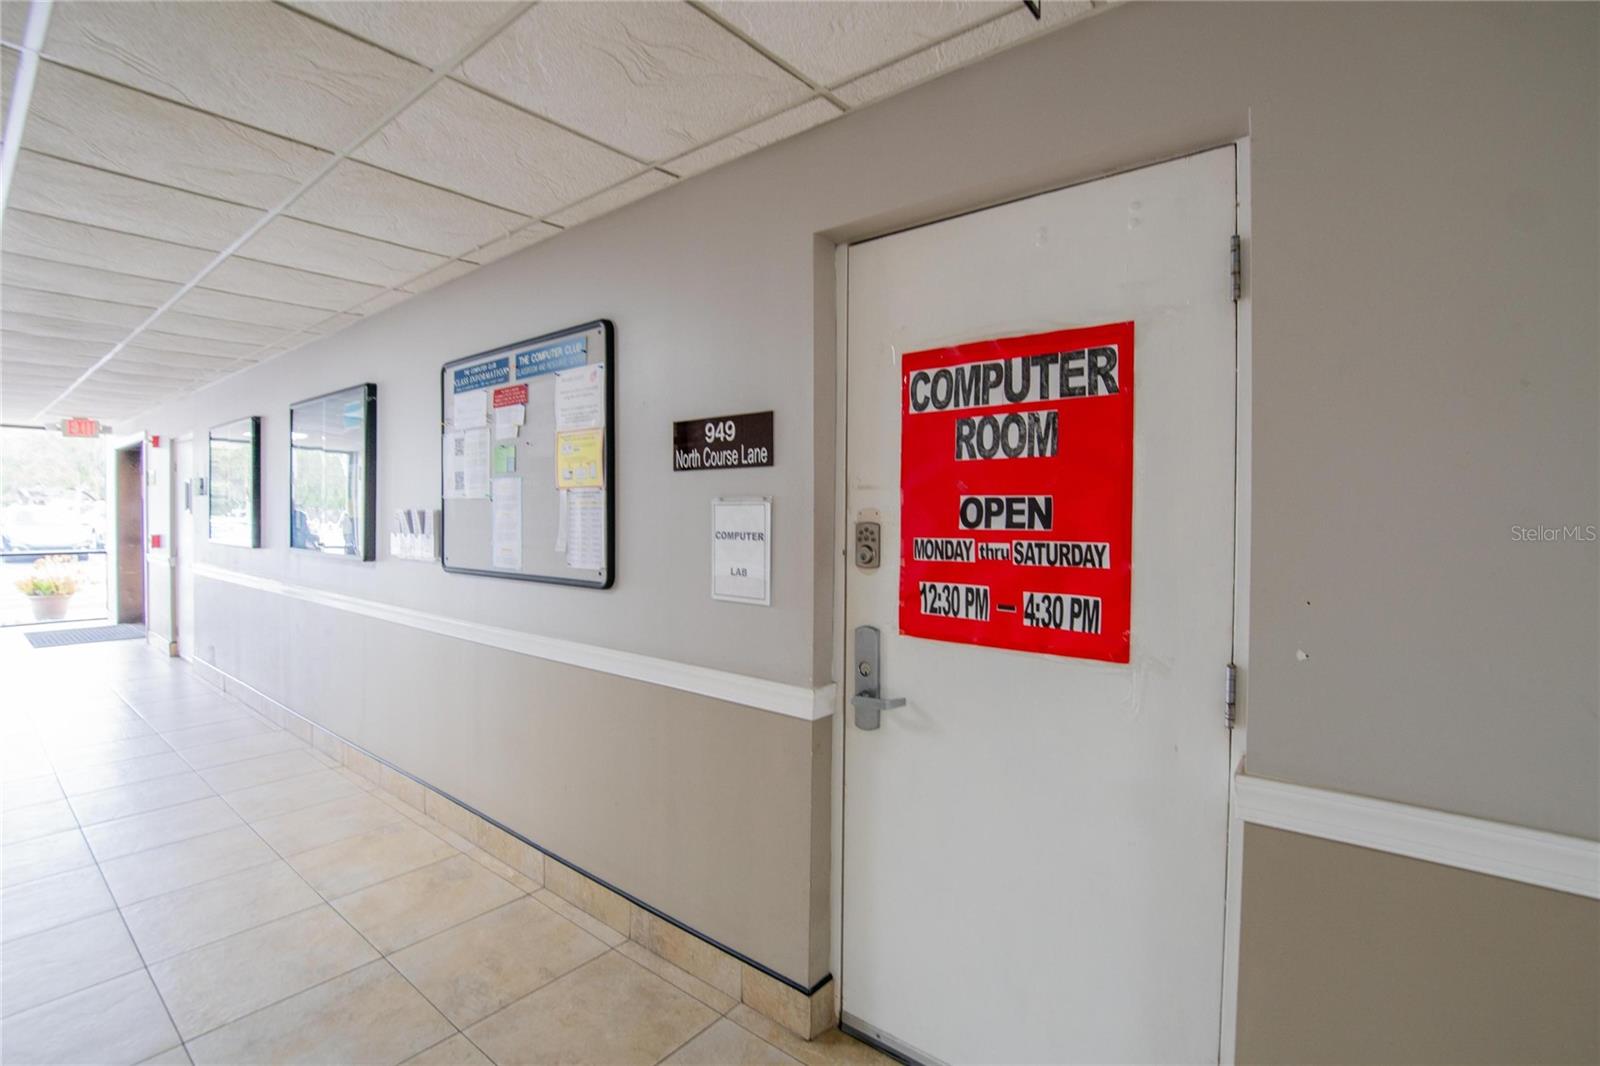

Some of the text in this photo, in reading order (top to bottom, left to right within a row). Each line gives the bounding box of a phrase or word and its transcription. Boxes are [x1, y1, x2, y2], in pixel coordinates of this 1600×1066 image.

[518, 354, 530, 366] THE
[530, 347, 563, 364] COMPUTER
[911, 347, 1119, 412] COMPUTER
[68, 420, 96, 435] EXIT
[705, 420, 736, 443] 949
[956, 411, 1058, 460] ROOM
[675, 443, 768, 469] North Course Lane
[960, 496, 1052, 530] OPEN
[715, 531, 764, 541] COMPUTER
[914, 538, 1107, 568] MONDAY thru SATURDAY
[730, 567, 747, 577] LAB
[920, 583, 960, 615] 12:30
[965, 586, 988, 620] PM
[1024, 593, 1064, 629] 4:30
[1069, 597, 1100, 635] PM
